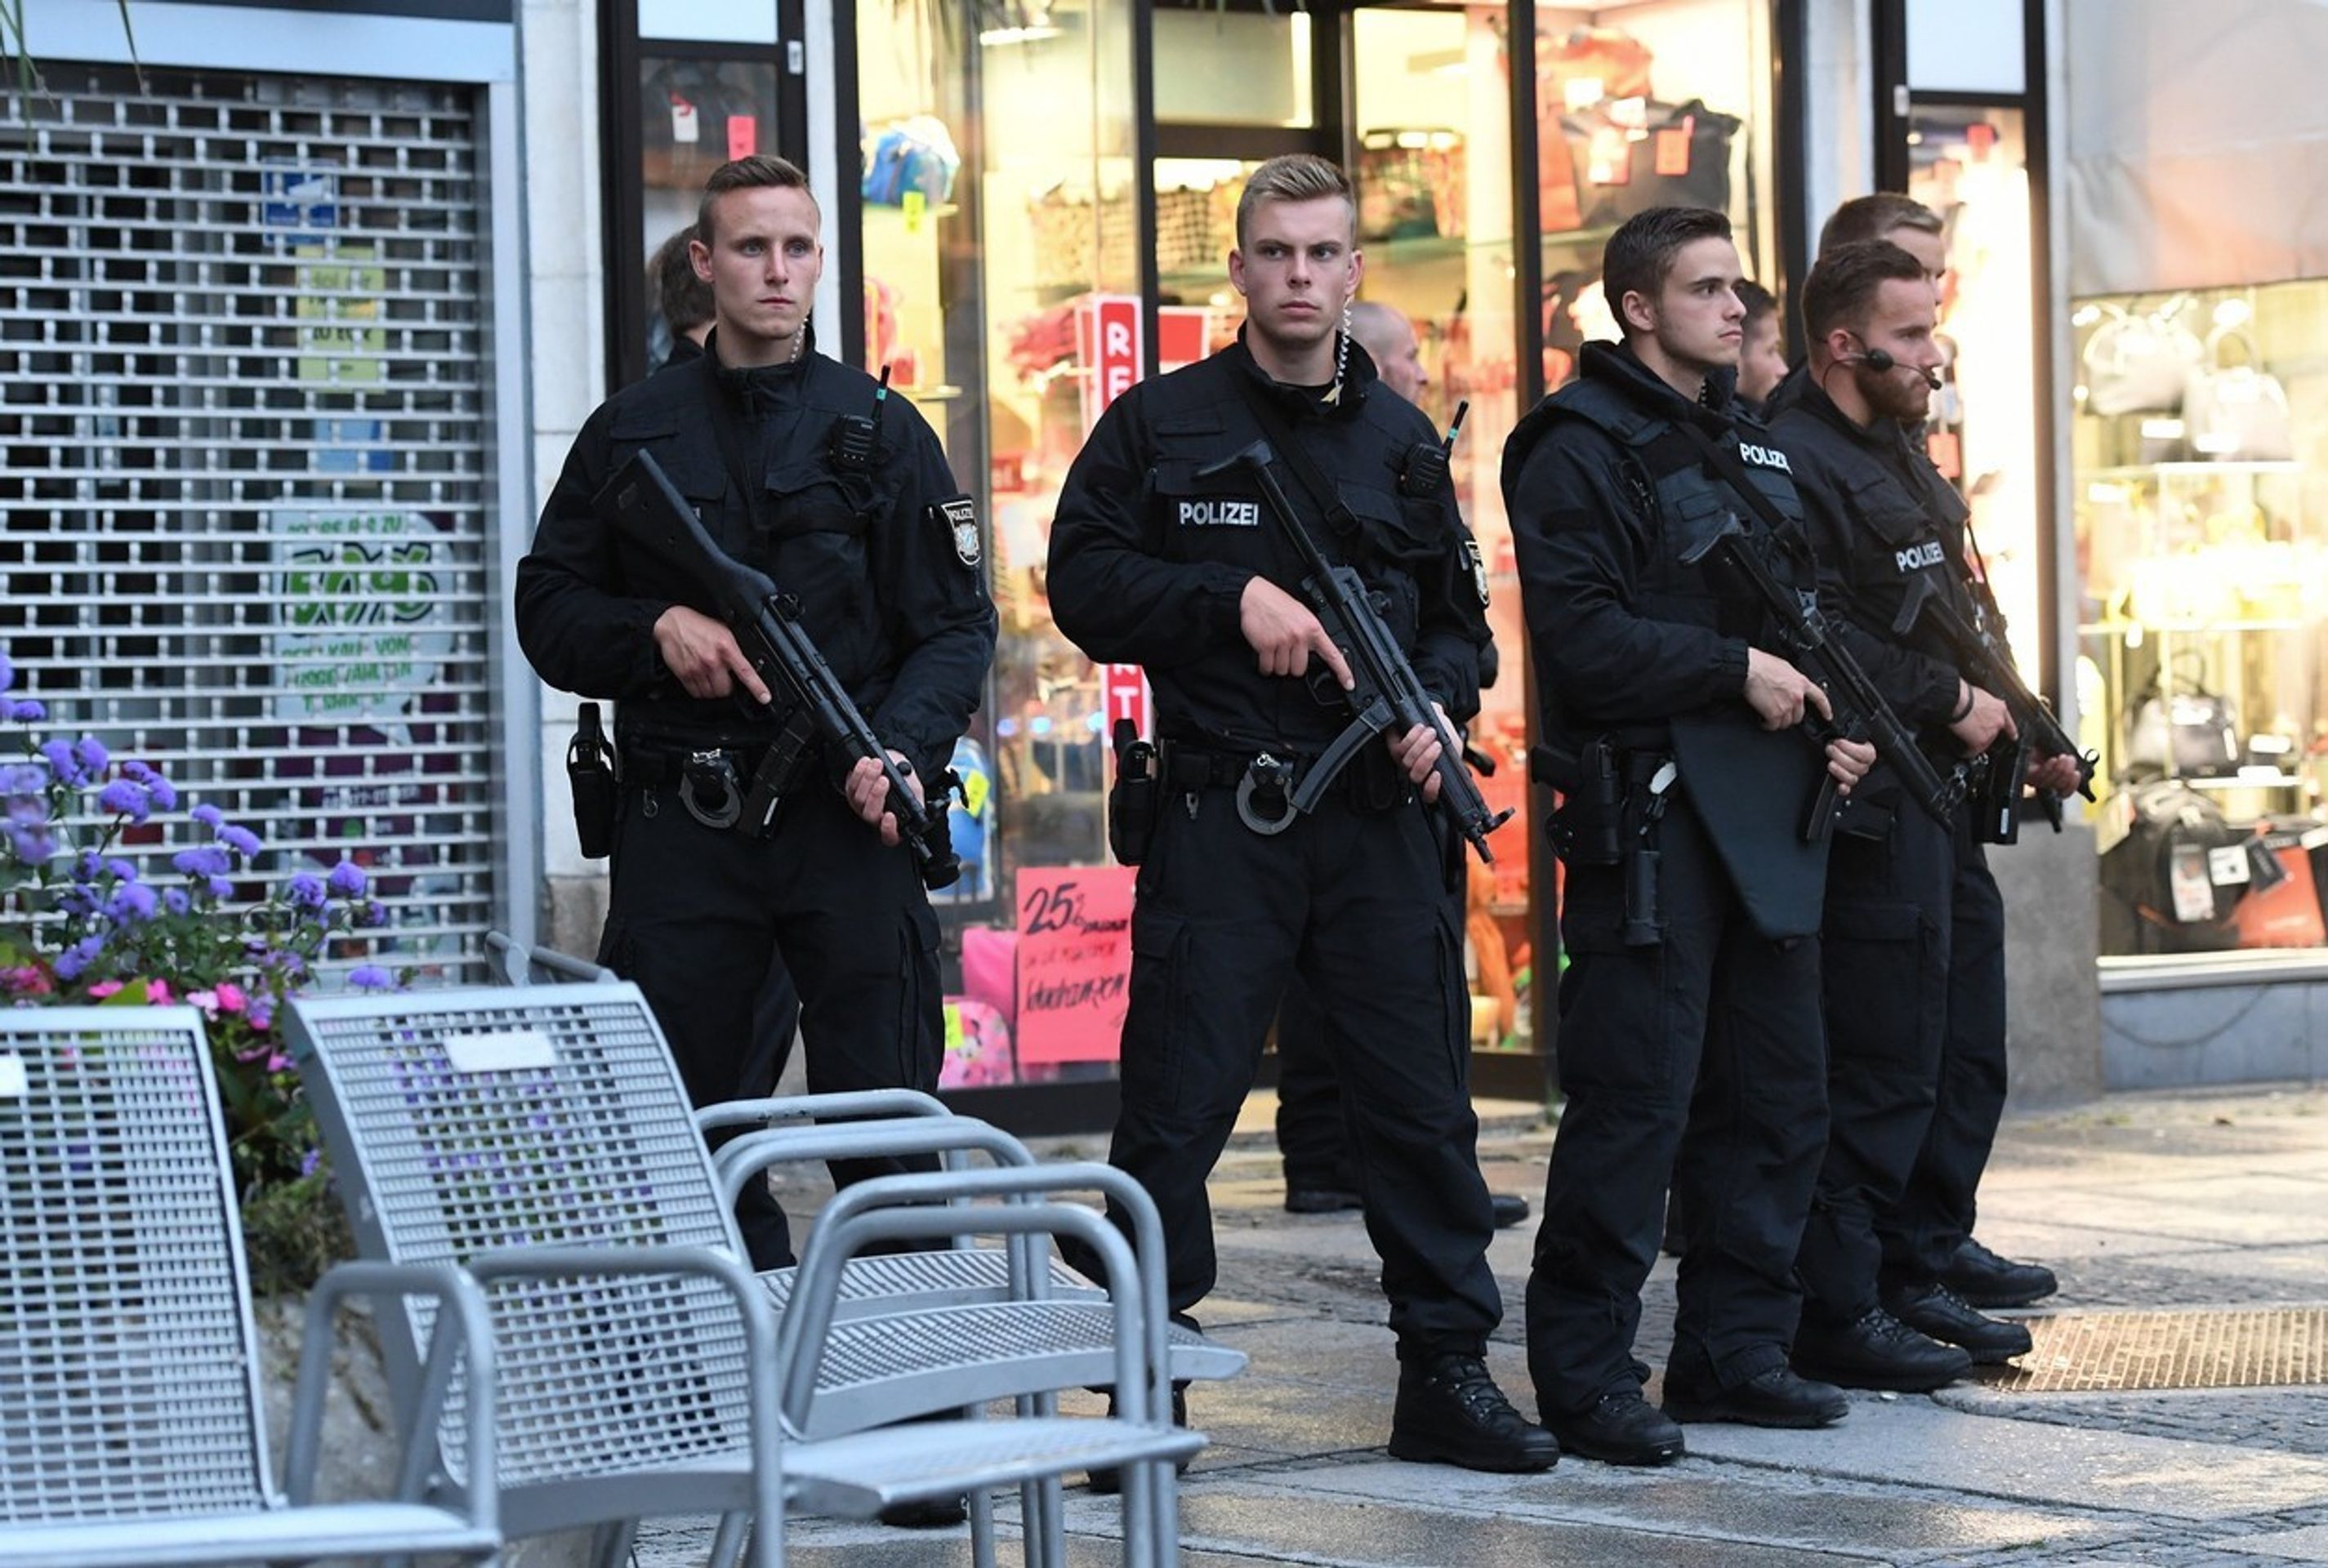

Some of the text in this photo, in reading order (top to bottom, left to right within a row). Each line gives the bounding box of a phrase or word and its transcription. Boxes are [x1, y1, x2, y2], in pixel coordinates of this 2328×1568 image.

[1739, 443, 1793, 475] POLIZ
[1179, 501, 1259, 525] POLIZEI
[1895, 541, 1945, 572] POLIZEI
